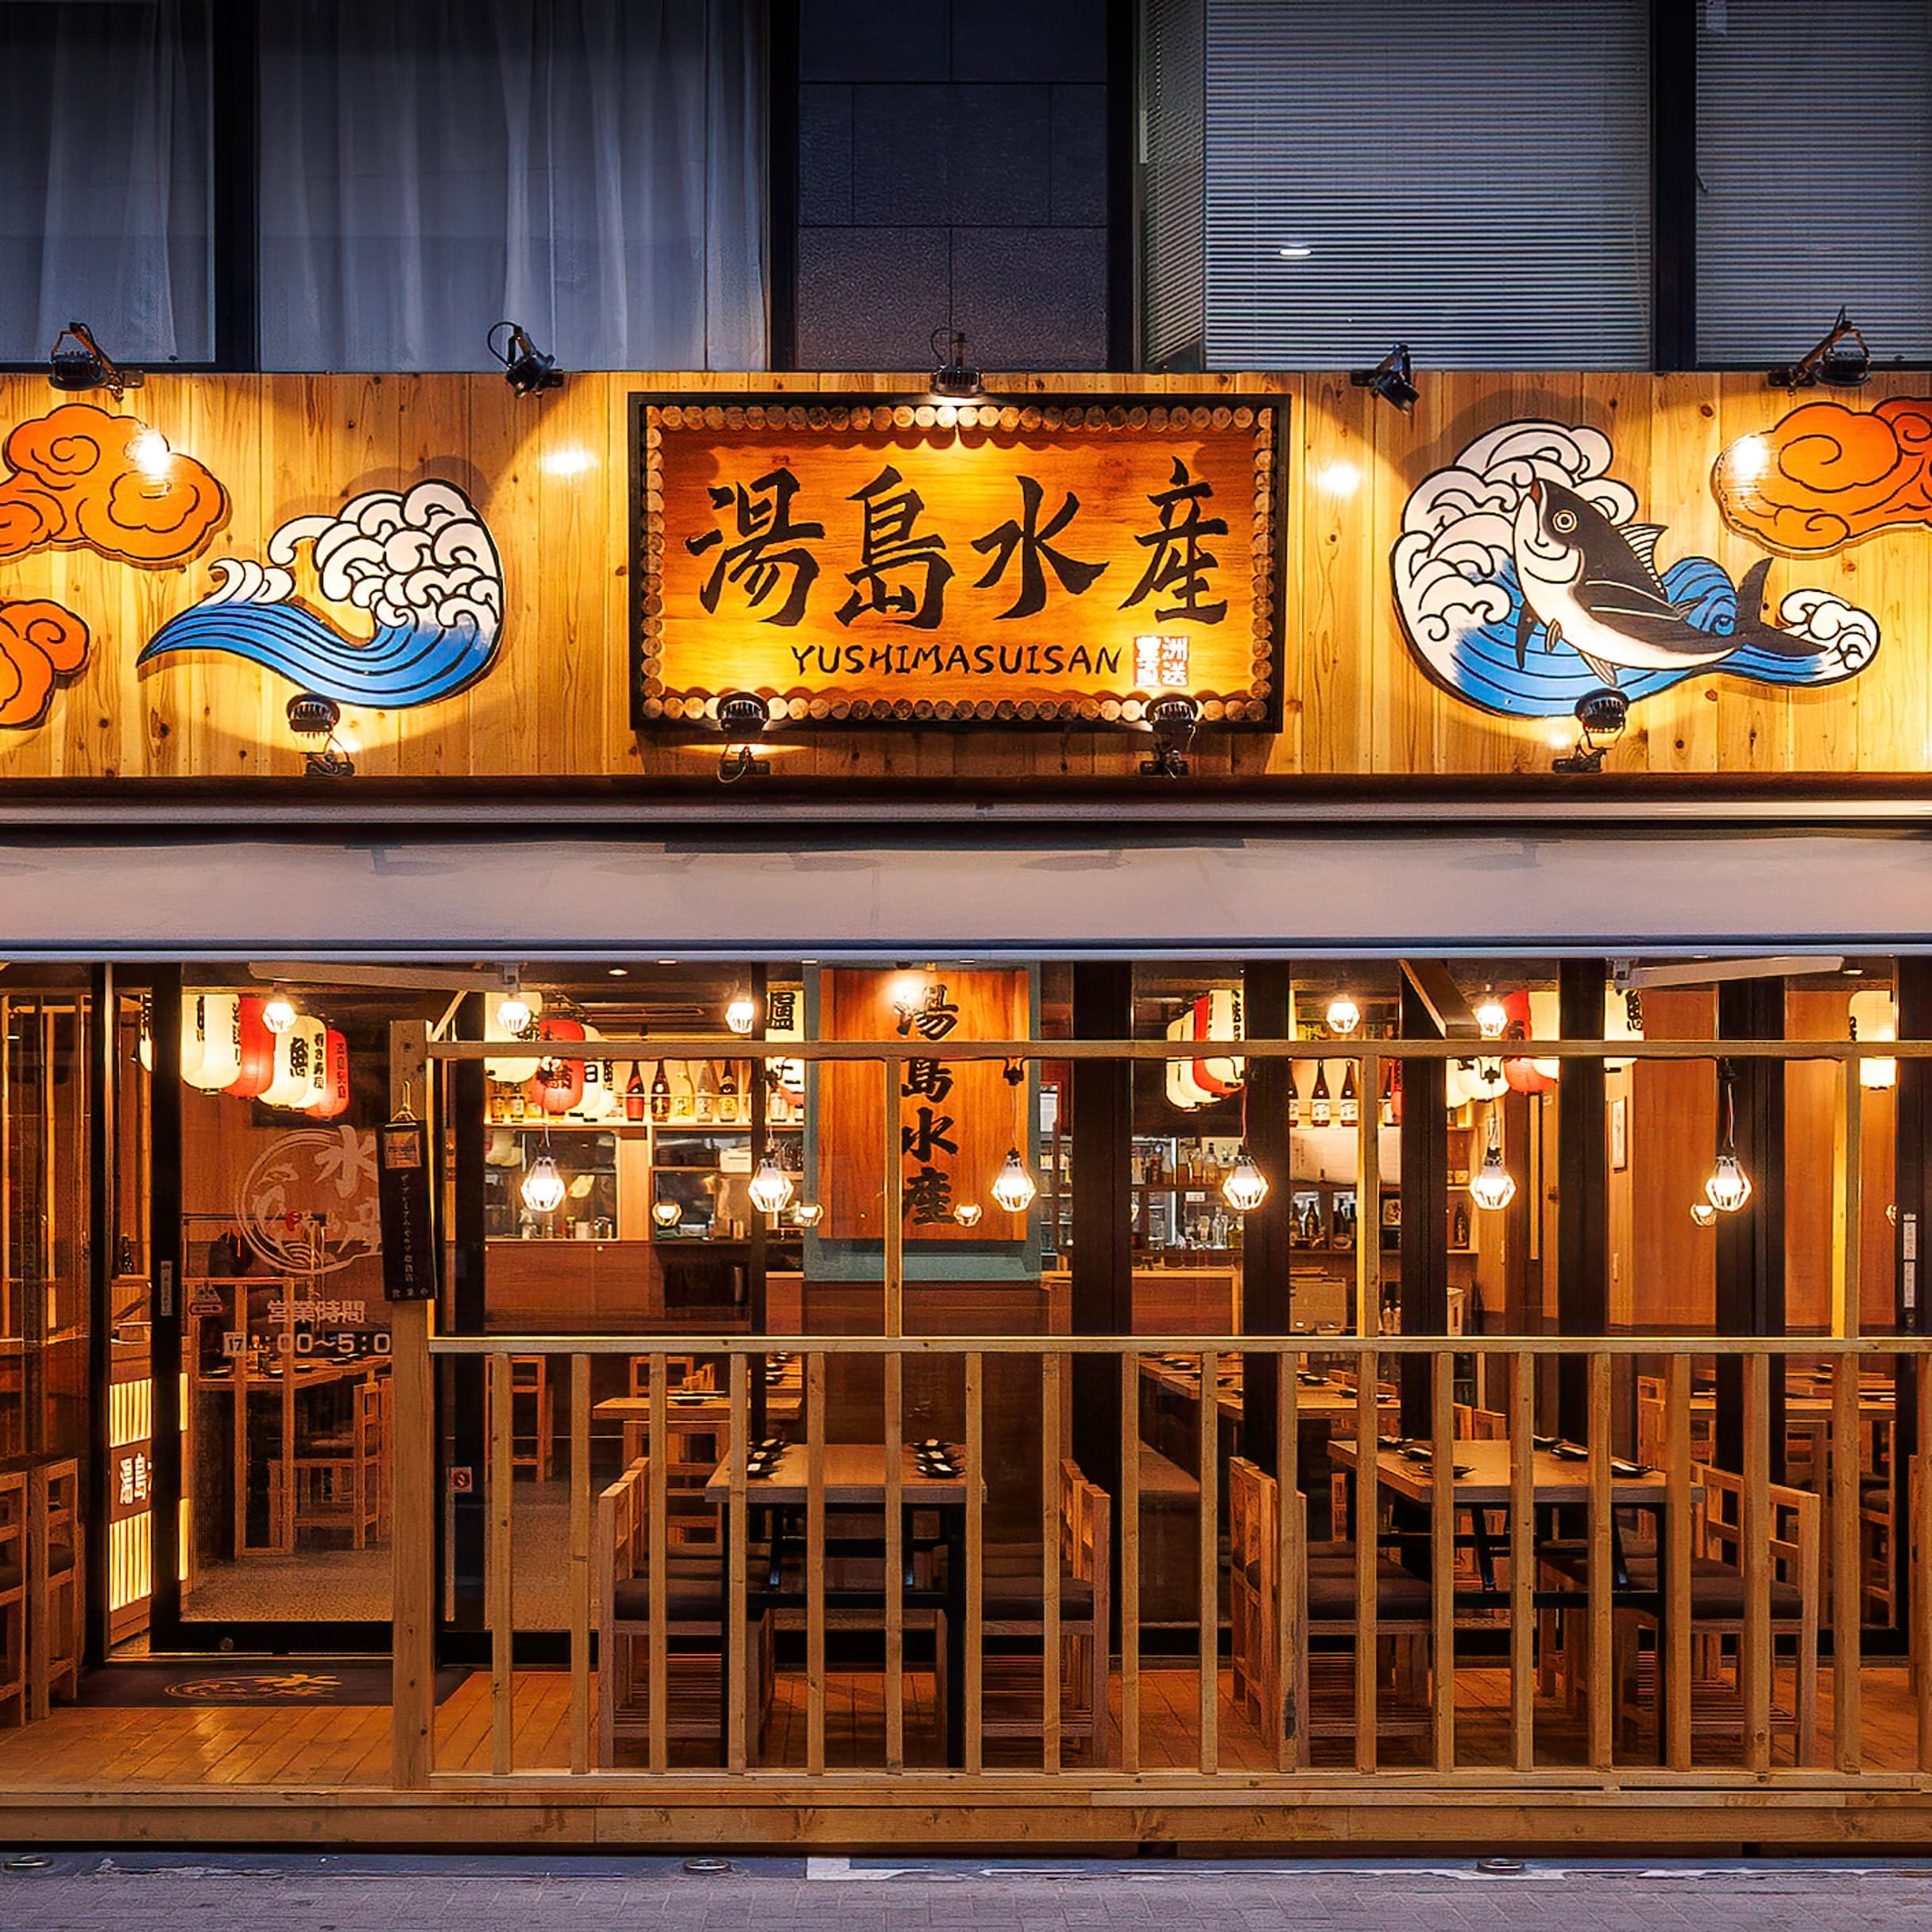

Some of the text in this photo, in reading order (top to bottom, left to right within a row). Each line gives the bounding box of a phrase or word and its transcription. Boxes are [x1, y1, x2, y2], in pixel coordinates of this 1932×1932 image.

[685, 456, 1230, 629] 湯島水産
[791, 644, 1122, 677] YUSHIMASUISAN
[267, 1300, 365, 1323] 営業時間
